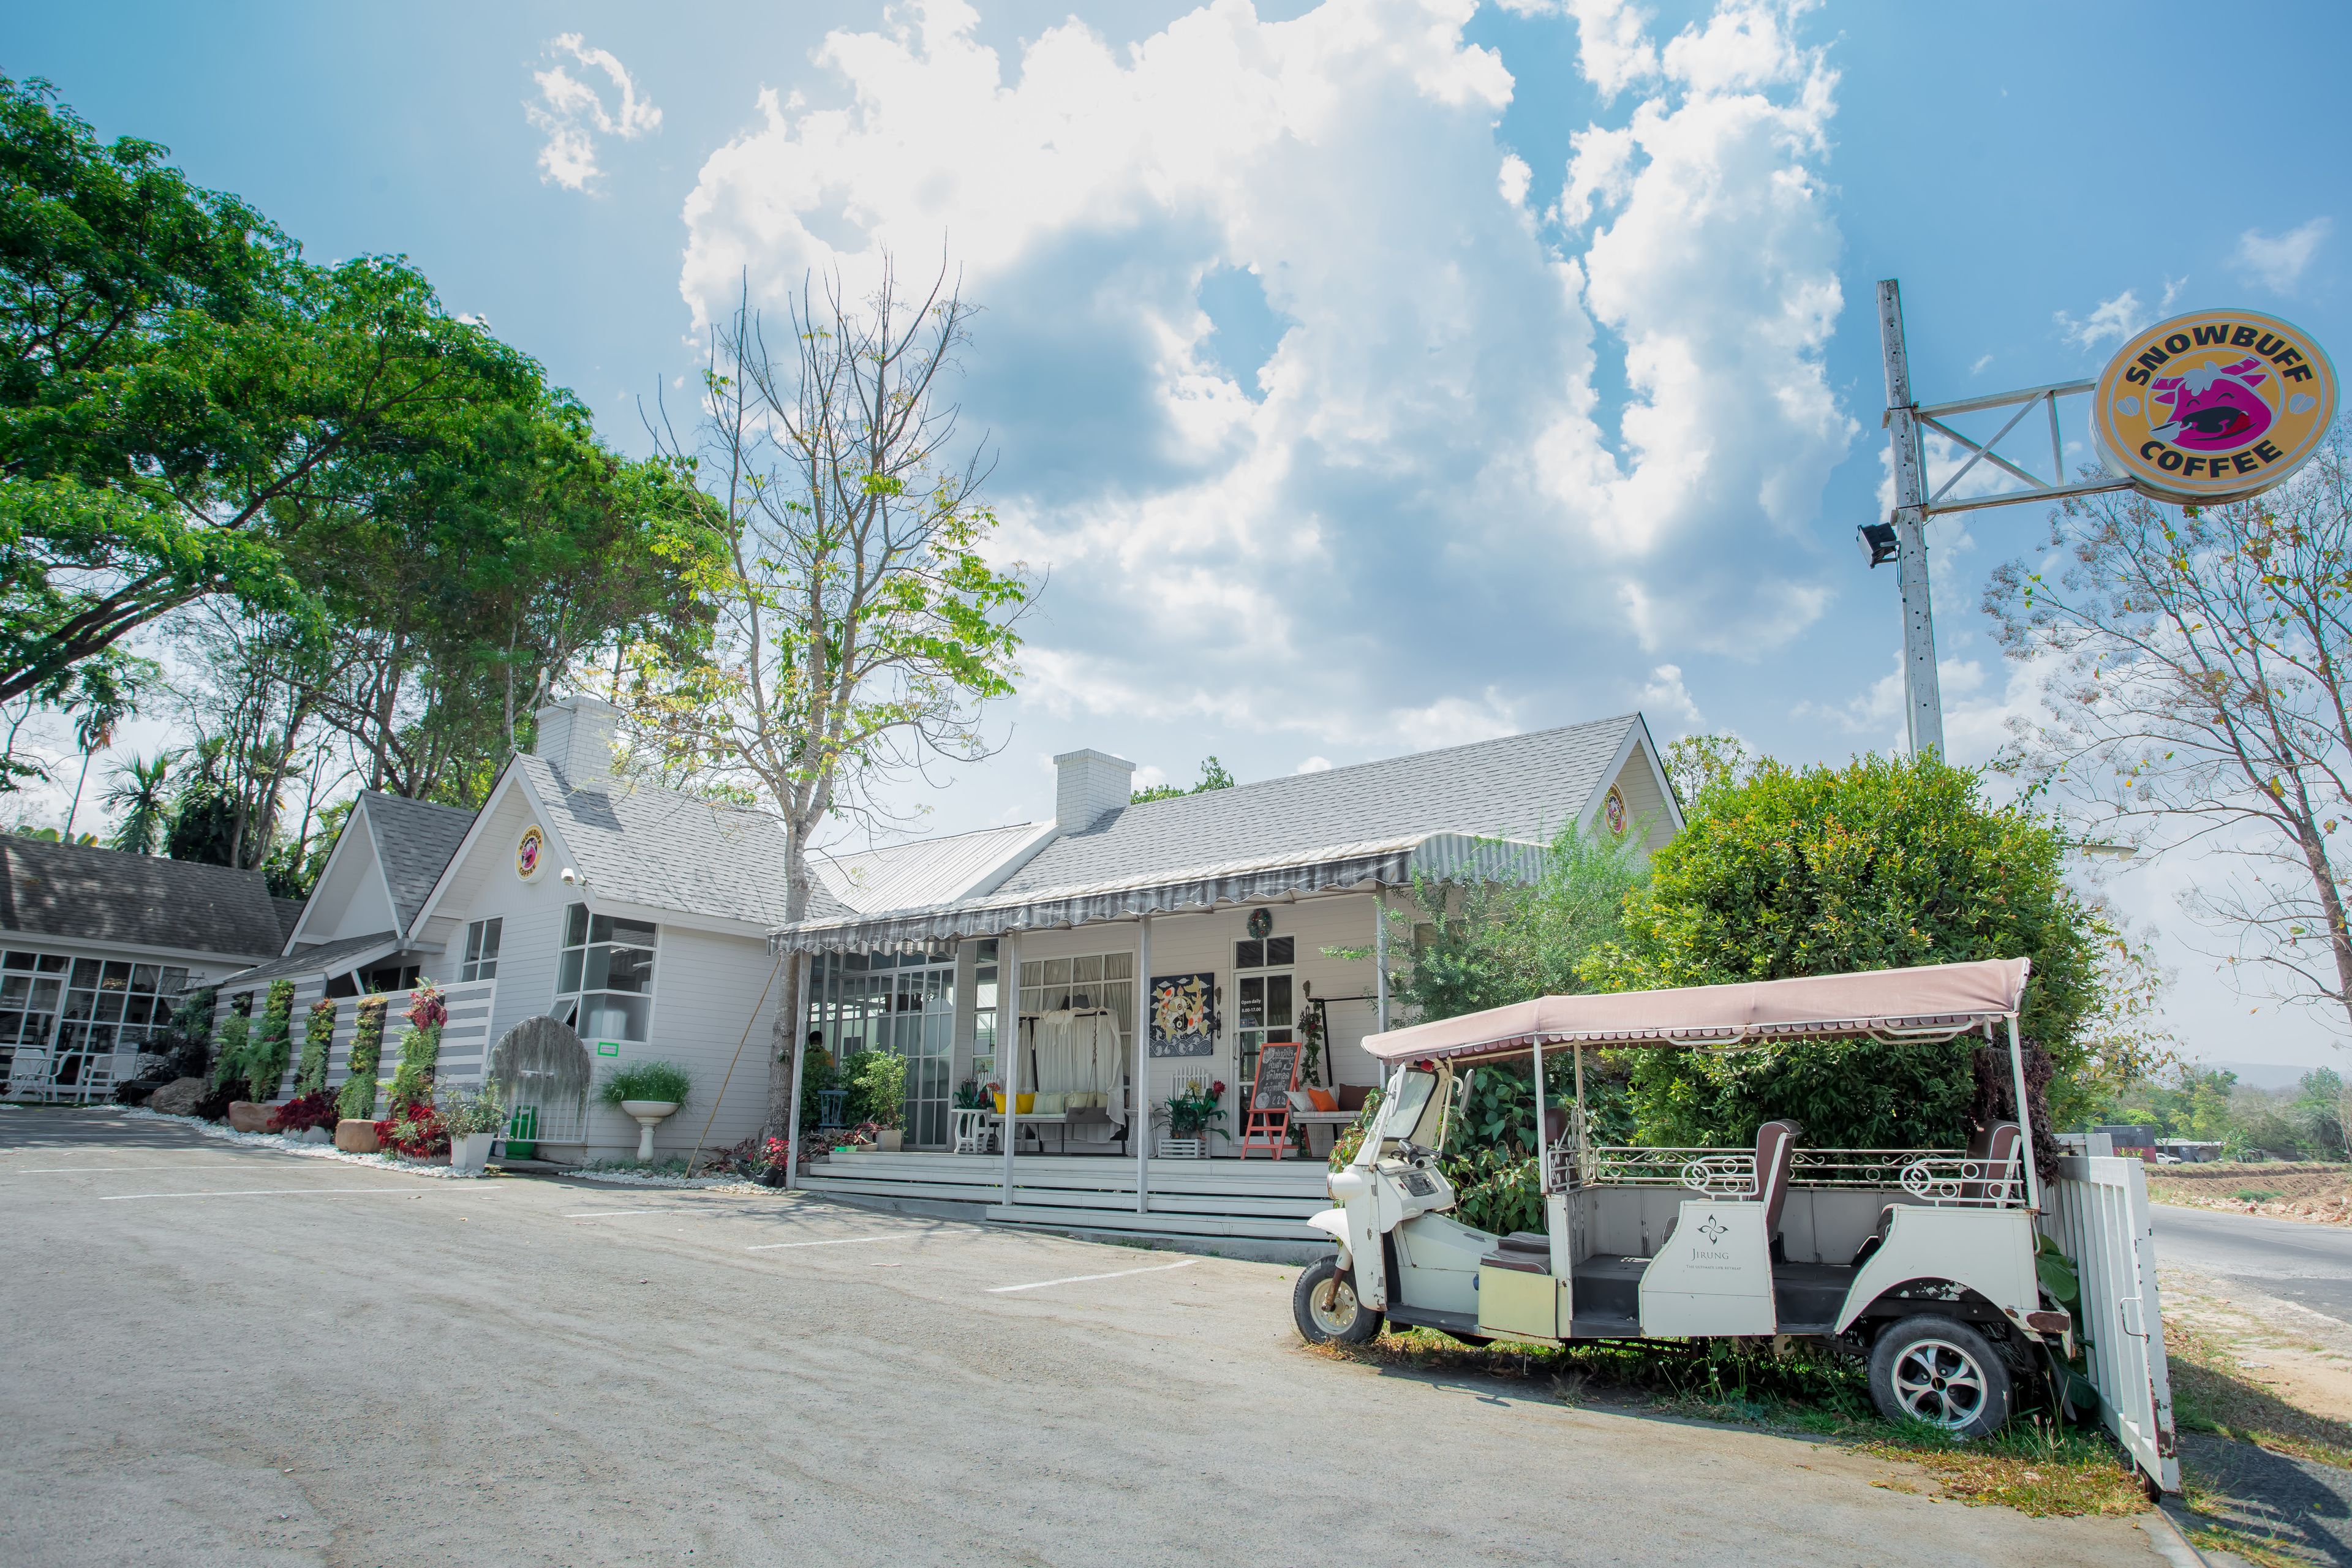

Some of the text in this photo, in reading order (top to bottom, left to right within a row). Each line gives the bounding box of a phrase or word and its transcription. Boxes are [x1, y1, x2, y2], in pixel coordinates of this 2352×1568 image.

[2125, 324, 2313, 386] SNOWBUFF
[2140, 439, 2284, 478] COFFEE
[519, 829, 542, 850] SNOWBUFF
[519, 863, 537, 876] COFFEE
